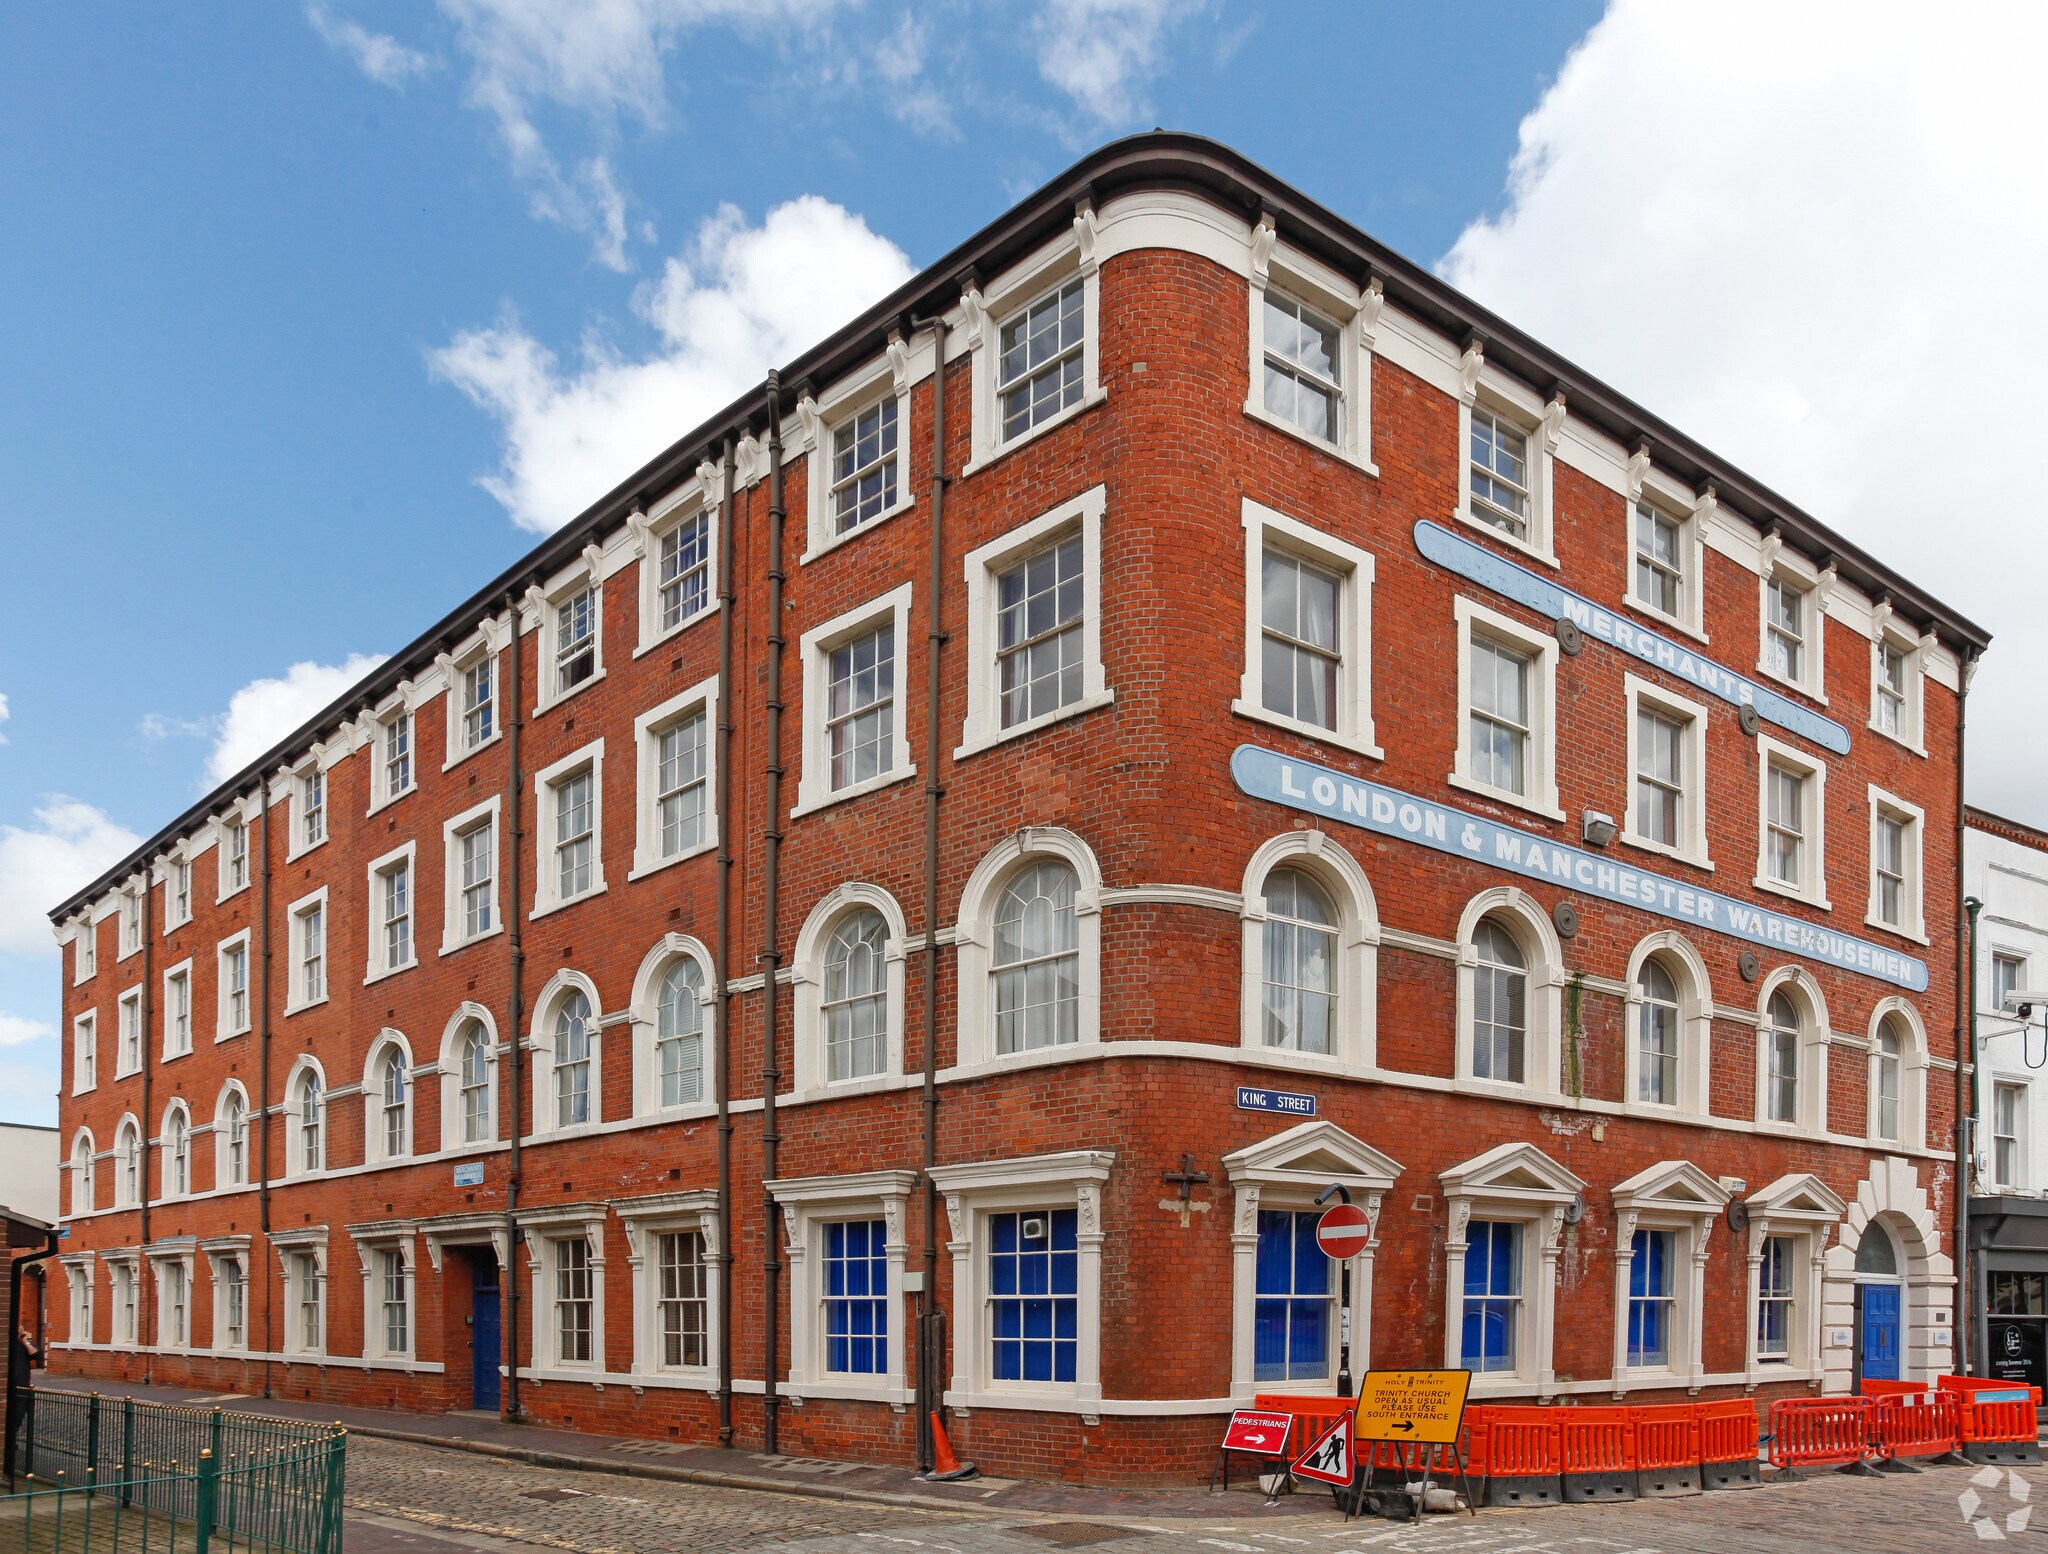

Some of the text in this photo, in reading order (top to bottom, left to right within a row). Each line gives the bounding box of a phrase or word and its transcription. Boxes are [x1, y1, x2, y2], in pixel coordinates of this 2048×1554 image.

[1563, 595, 1753, 705] MERCHANTS
[1281, 765, 1911, 982] LONDON & MANCHESTER WAREHOUSEMEN
[1242, 1091, 1311, 1112] KING STREET
[1411, 1390, 1451, 1398] CHURCH
[1381, 1404, 1414, 1412] PLEASE
[1400, 1412, 1449, 1420] ENTRANCE
[1233, 1417, 1287, 1429] PEDESTRIANS
